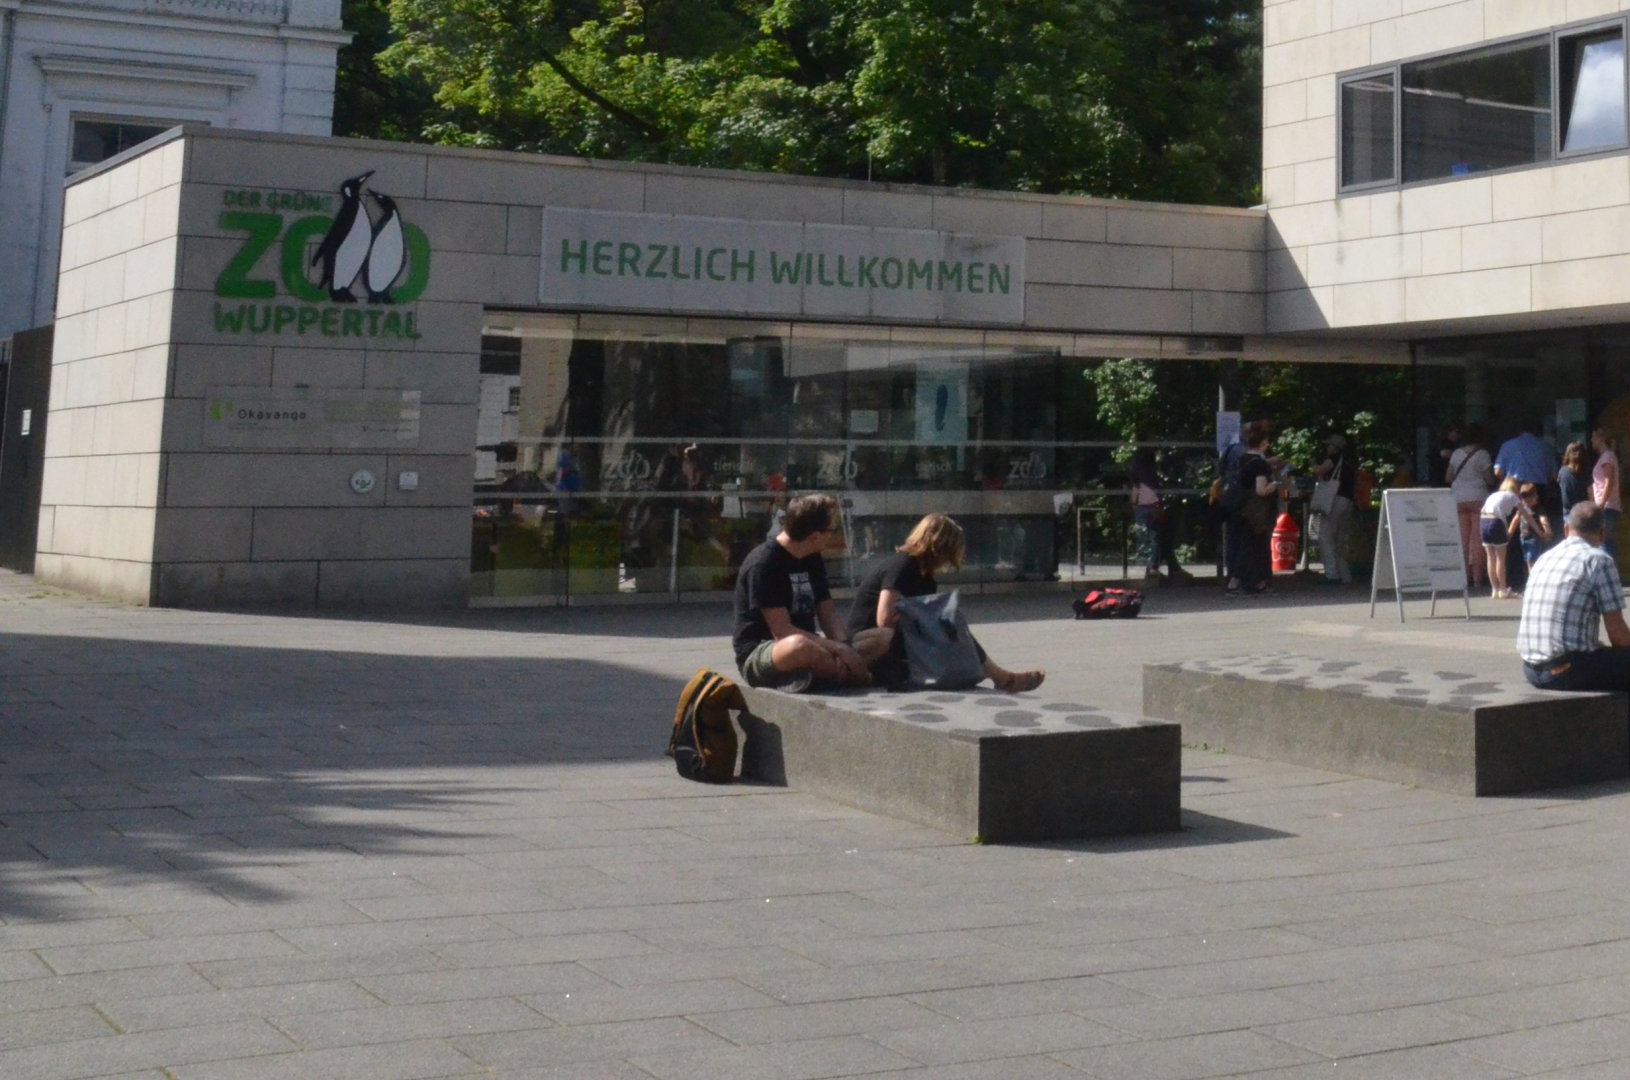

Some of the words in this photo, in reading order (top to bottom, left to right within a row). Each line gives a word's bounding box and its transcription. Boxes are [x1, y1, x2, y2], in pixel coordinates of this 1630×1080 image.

[223, 189, 262, 208] DER
[560, 238, 756, 283] HERZLICH
[769, 250, 1011, 295] WILLKOMMEN
[213, 302, 422, 340] WUPPERTAL
[237, 408, 307, 422] Okavango
